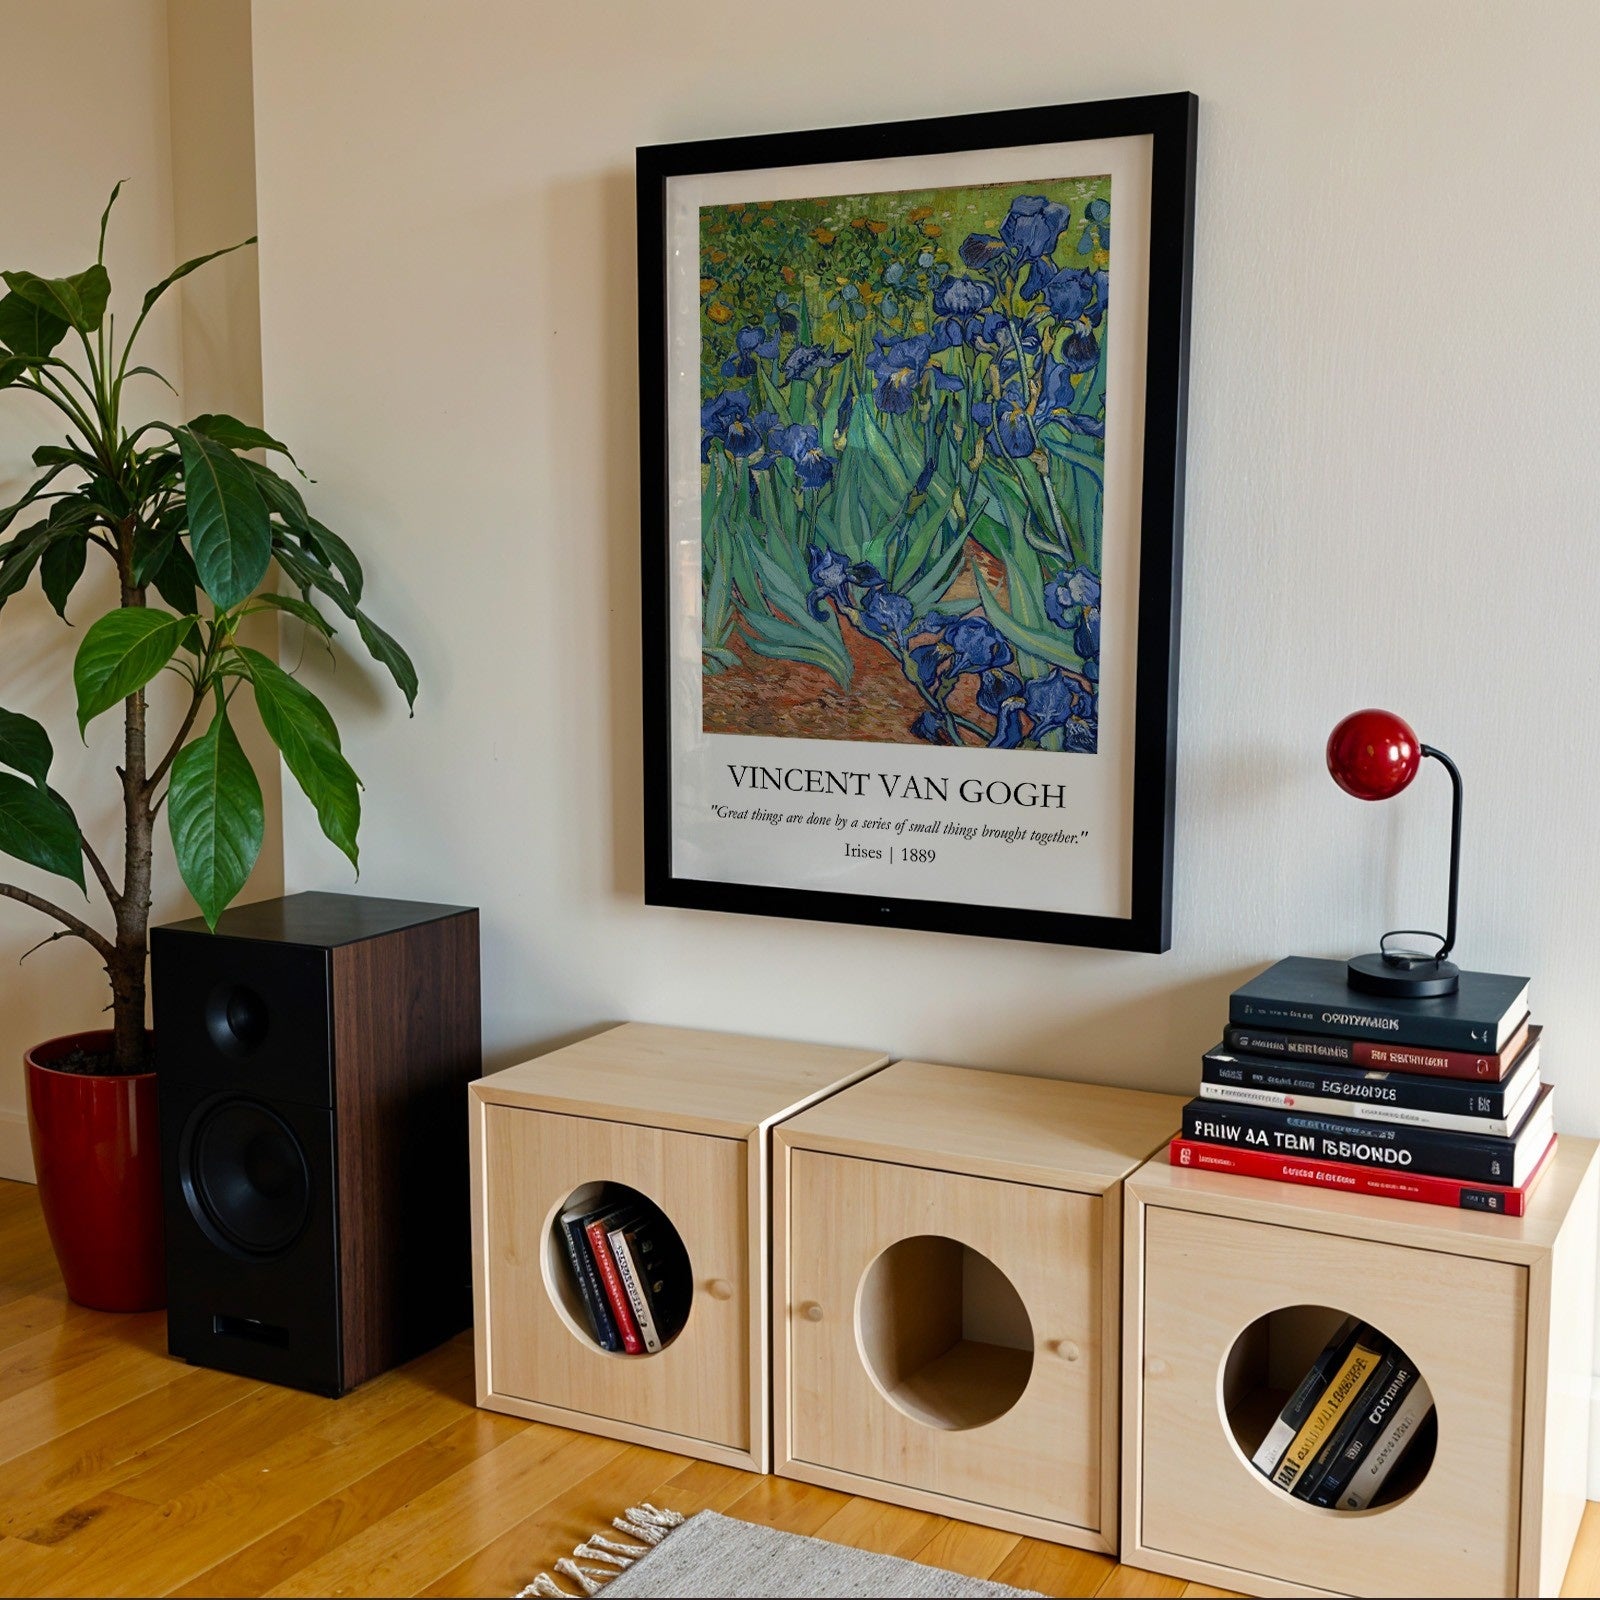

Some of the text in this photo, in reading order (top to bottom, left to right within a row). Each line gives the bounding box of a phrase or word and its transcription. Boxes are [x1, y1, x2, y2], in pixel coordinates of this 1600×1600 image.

[726, 764, 1067, 809] VINCENT VAN GOGH
[711, 804, 1089, 846] "Great things are done by a series of small things brought together."
[844, 842, 883, 860] Irises
[900, 847, 937, 863] 1889
